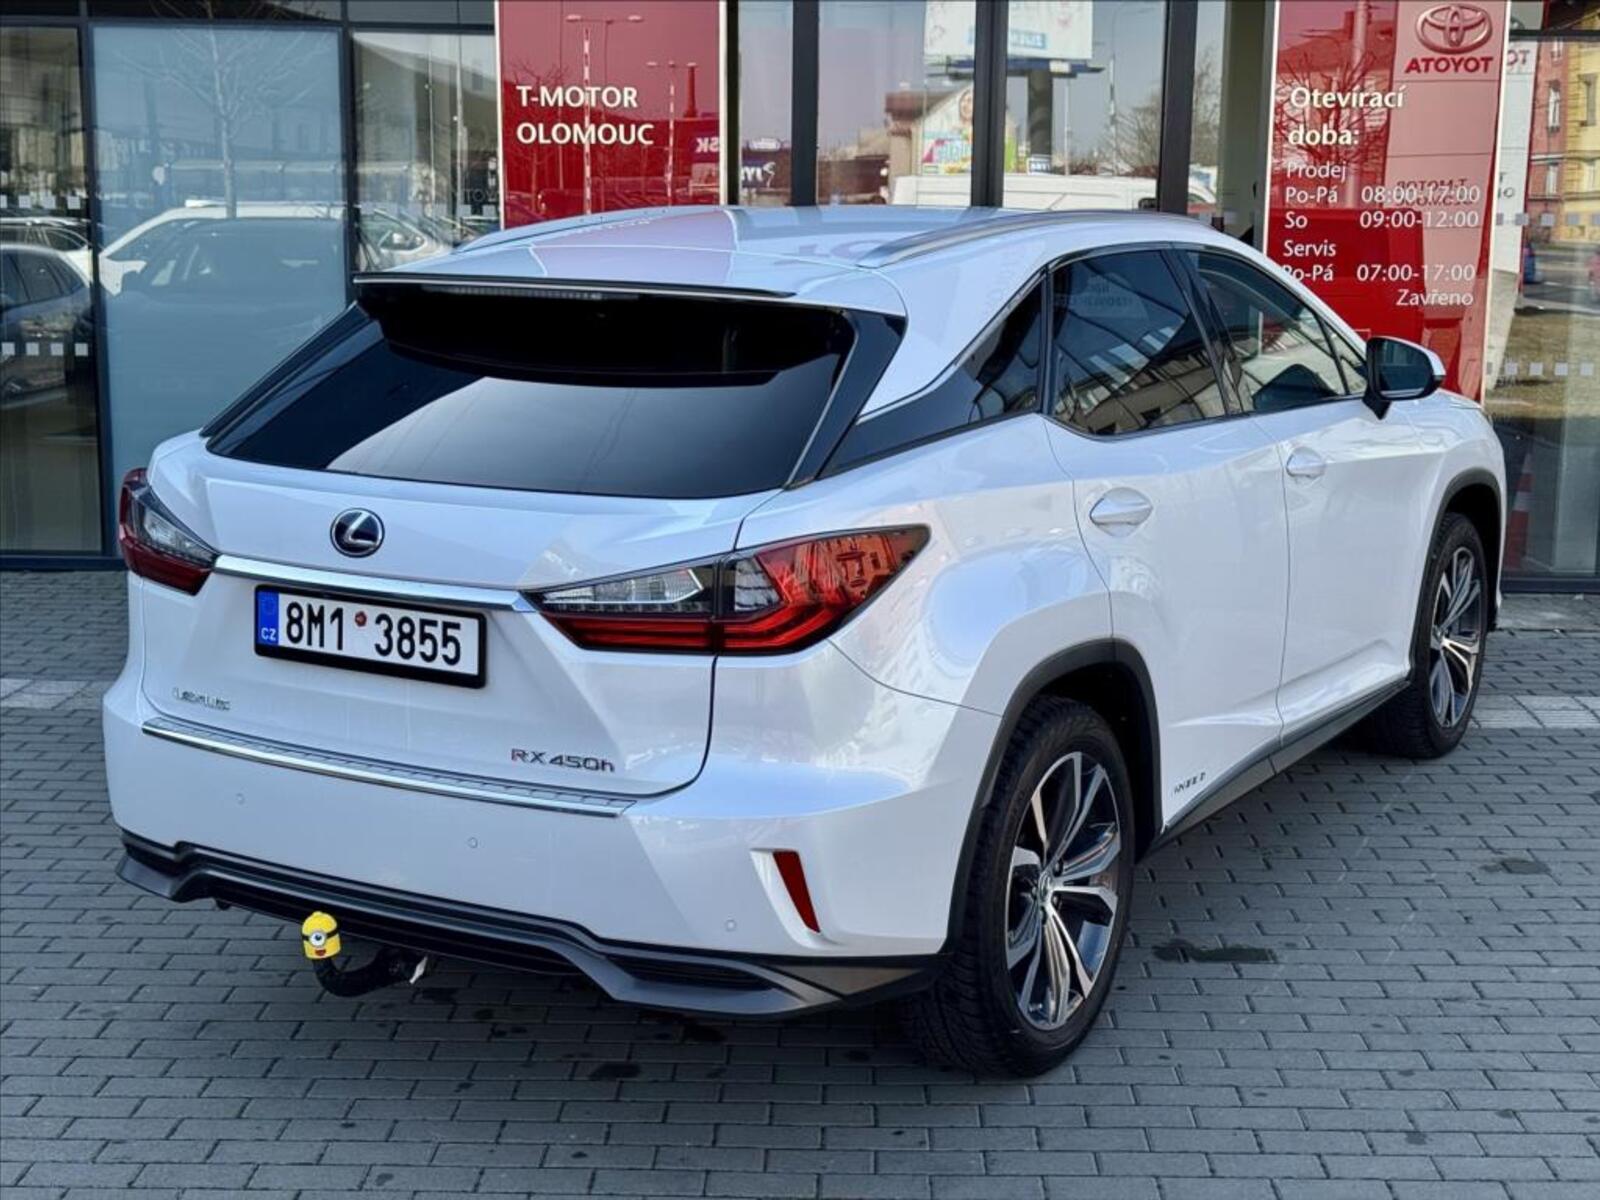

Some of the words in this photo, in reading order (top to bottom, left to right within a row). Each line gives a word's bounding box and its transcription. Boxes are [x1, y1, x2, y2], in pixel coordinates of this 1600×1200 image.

[516, 85, 638, 108] T-MOTOR
[1290, 84, 1407, 109] Otevírací
[516, 123, 654, 146] OLOMOUC
[1288, 124, 1361, 146] doba:
[1286, 161, 1347, 183] Prodej
[1284, 186, 1338, 204] Po-Pá
[1360, 186, 1481, 204] 08:00-17:00
[1284, 211, 1308, 229] So
[1359, 210, 1480, 229] 09:00-12:00
[1283, 239, 1337, 258] Servis
[1356, 263, 1476, 282] 07:00-17:00
[1395, 288, 1474, 307] Zavřeno
[260, 627, 277, 642] CZ
[285, 601, 344, 652] 8M1
[374, 612, 462, 667] 3855
[511, 747, 547, 765] RX
[548, 754, 615, 773] 450h
